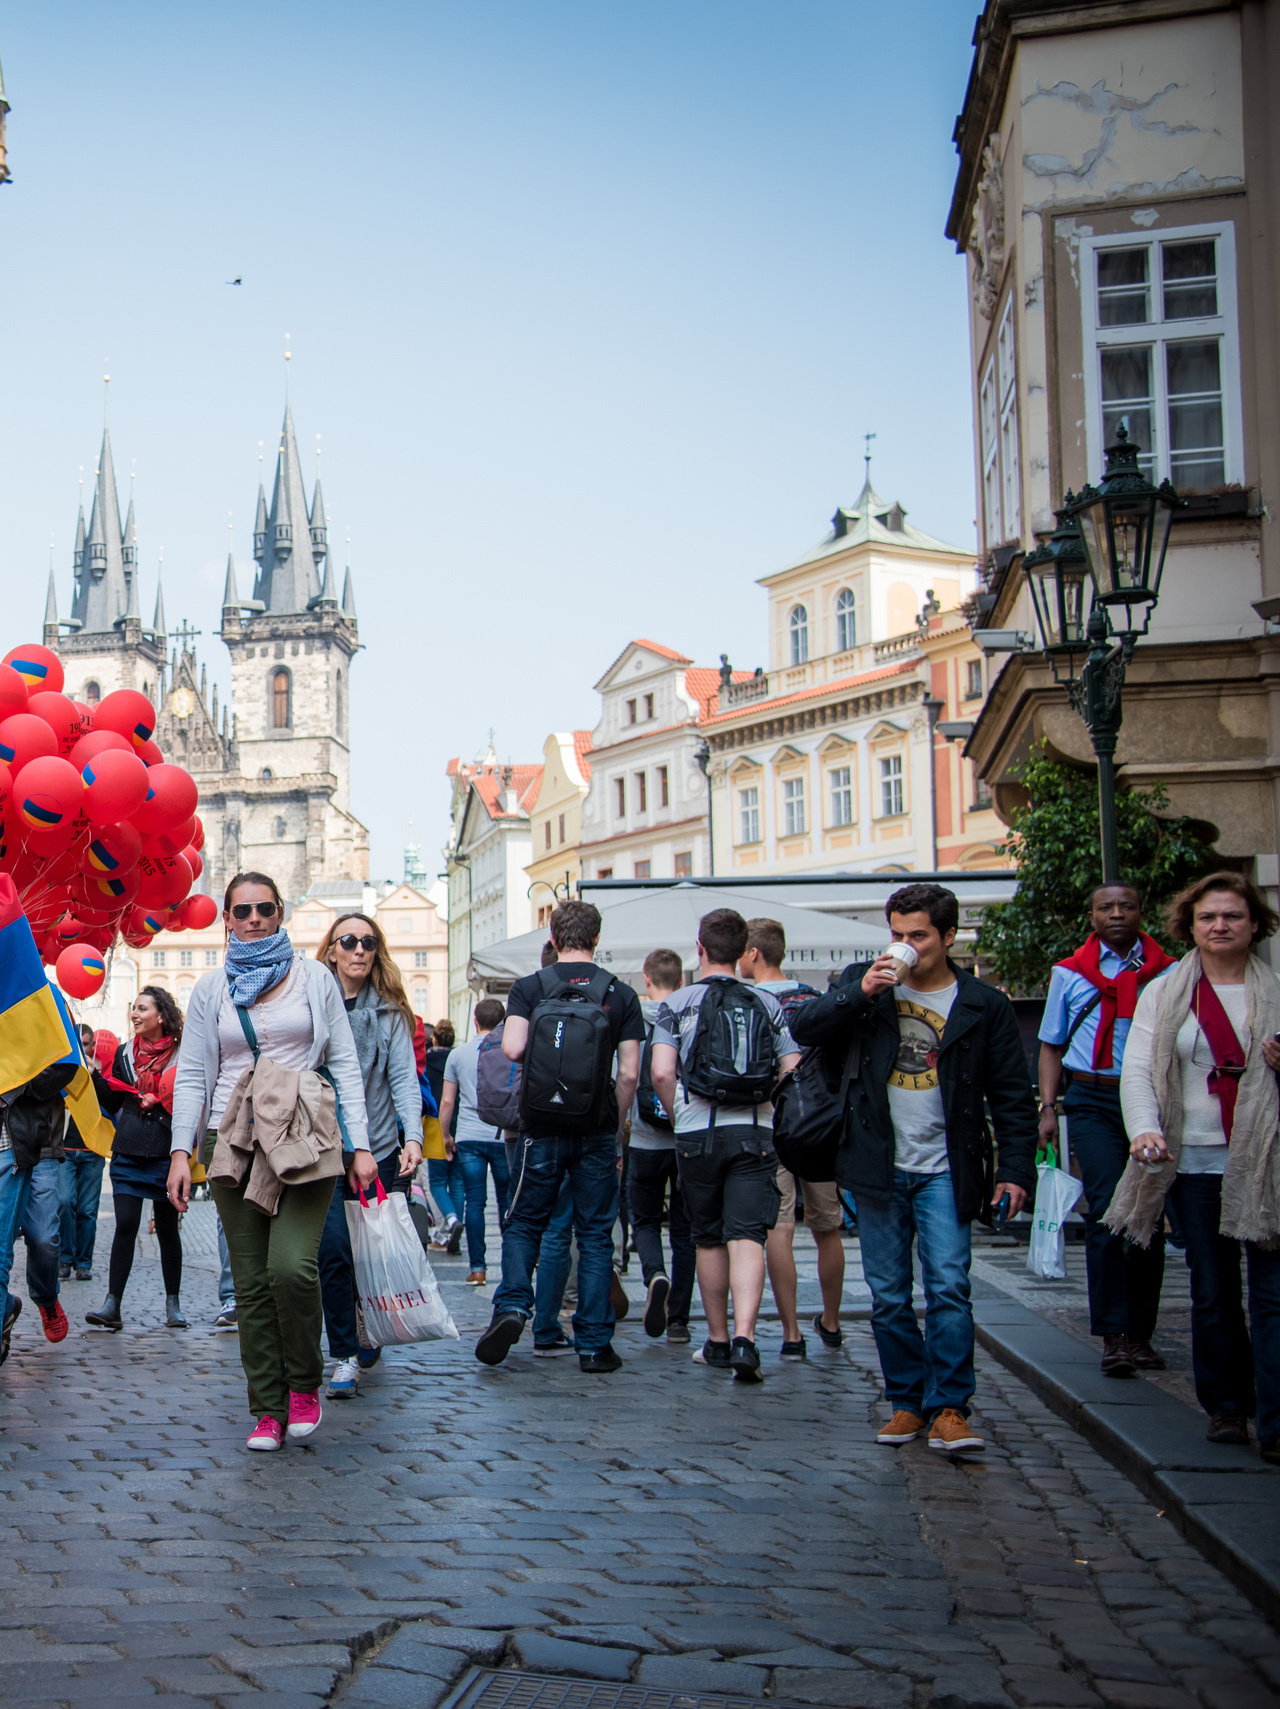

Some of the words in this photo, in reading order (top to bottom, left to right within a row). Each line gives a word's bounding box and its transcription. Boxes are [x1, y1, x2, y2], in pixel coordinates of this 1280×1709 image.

[163, 856, 177, 867] 15
[786, 949, 819, 962] TEL
[830, 949, 843, 963] U
[854, 949, 884, 962] PRI
[898, 1073, 935, 1089] SES
